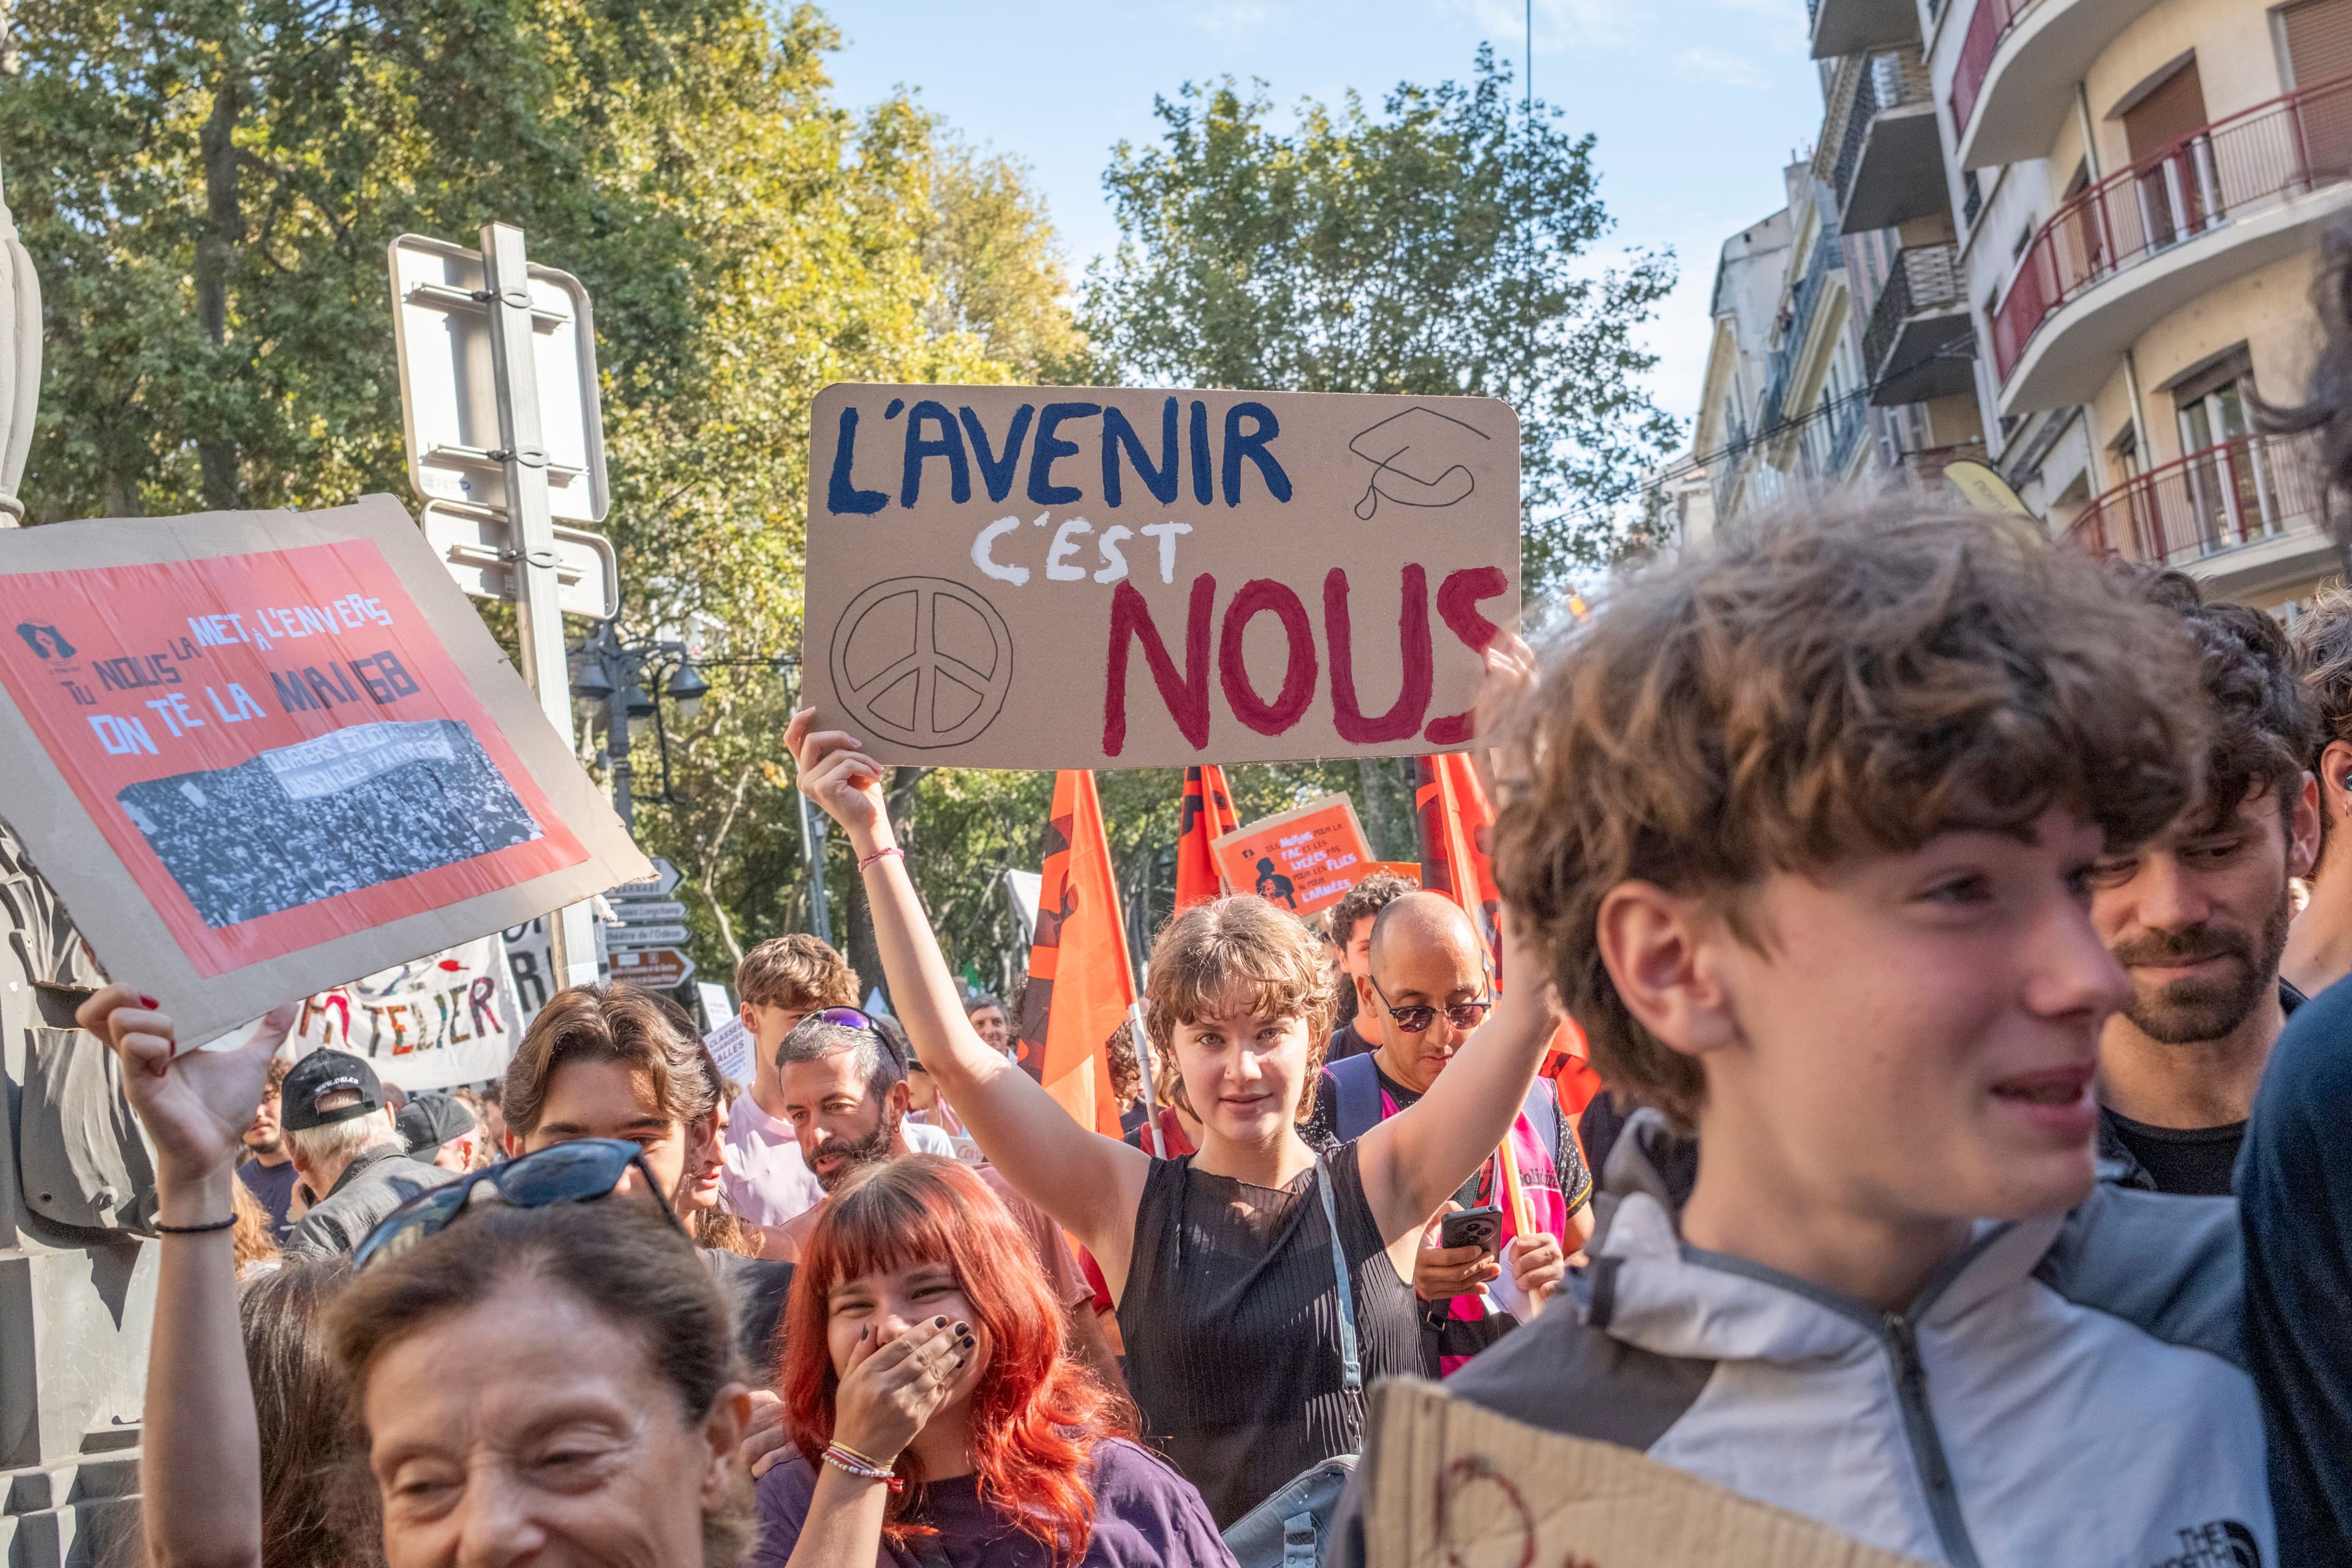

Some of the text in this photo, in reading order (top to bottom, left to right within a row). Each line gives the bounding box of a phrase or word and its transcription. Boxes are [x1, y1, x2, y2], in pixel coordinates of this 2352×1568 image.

[827, 396, 1293, 516] L'AVENIR
[971, 511, 1193, 586] C'EST
[187, 613, 251, 647] MET
[255, 593, 394, 638] L'ENVERS
[168, 636, 202, 662] LA
[254, 628, 274, 651] À
[91, 653, 183, 692] NOUS
[1102, 562, 1509, 758] NOUS
[87, 649, 421, 755] ON TE LA MAI 68
[1302, 845, 1311, 853] ET
[1313, 840, 1328, 849] LES
[1313, 865, 1327, 875] LES
